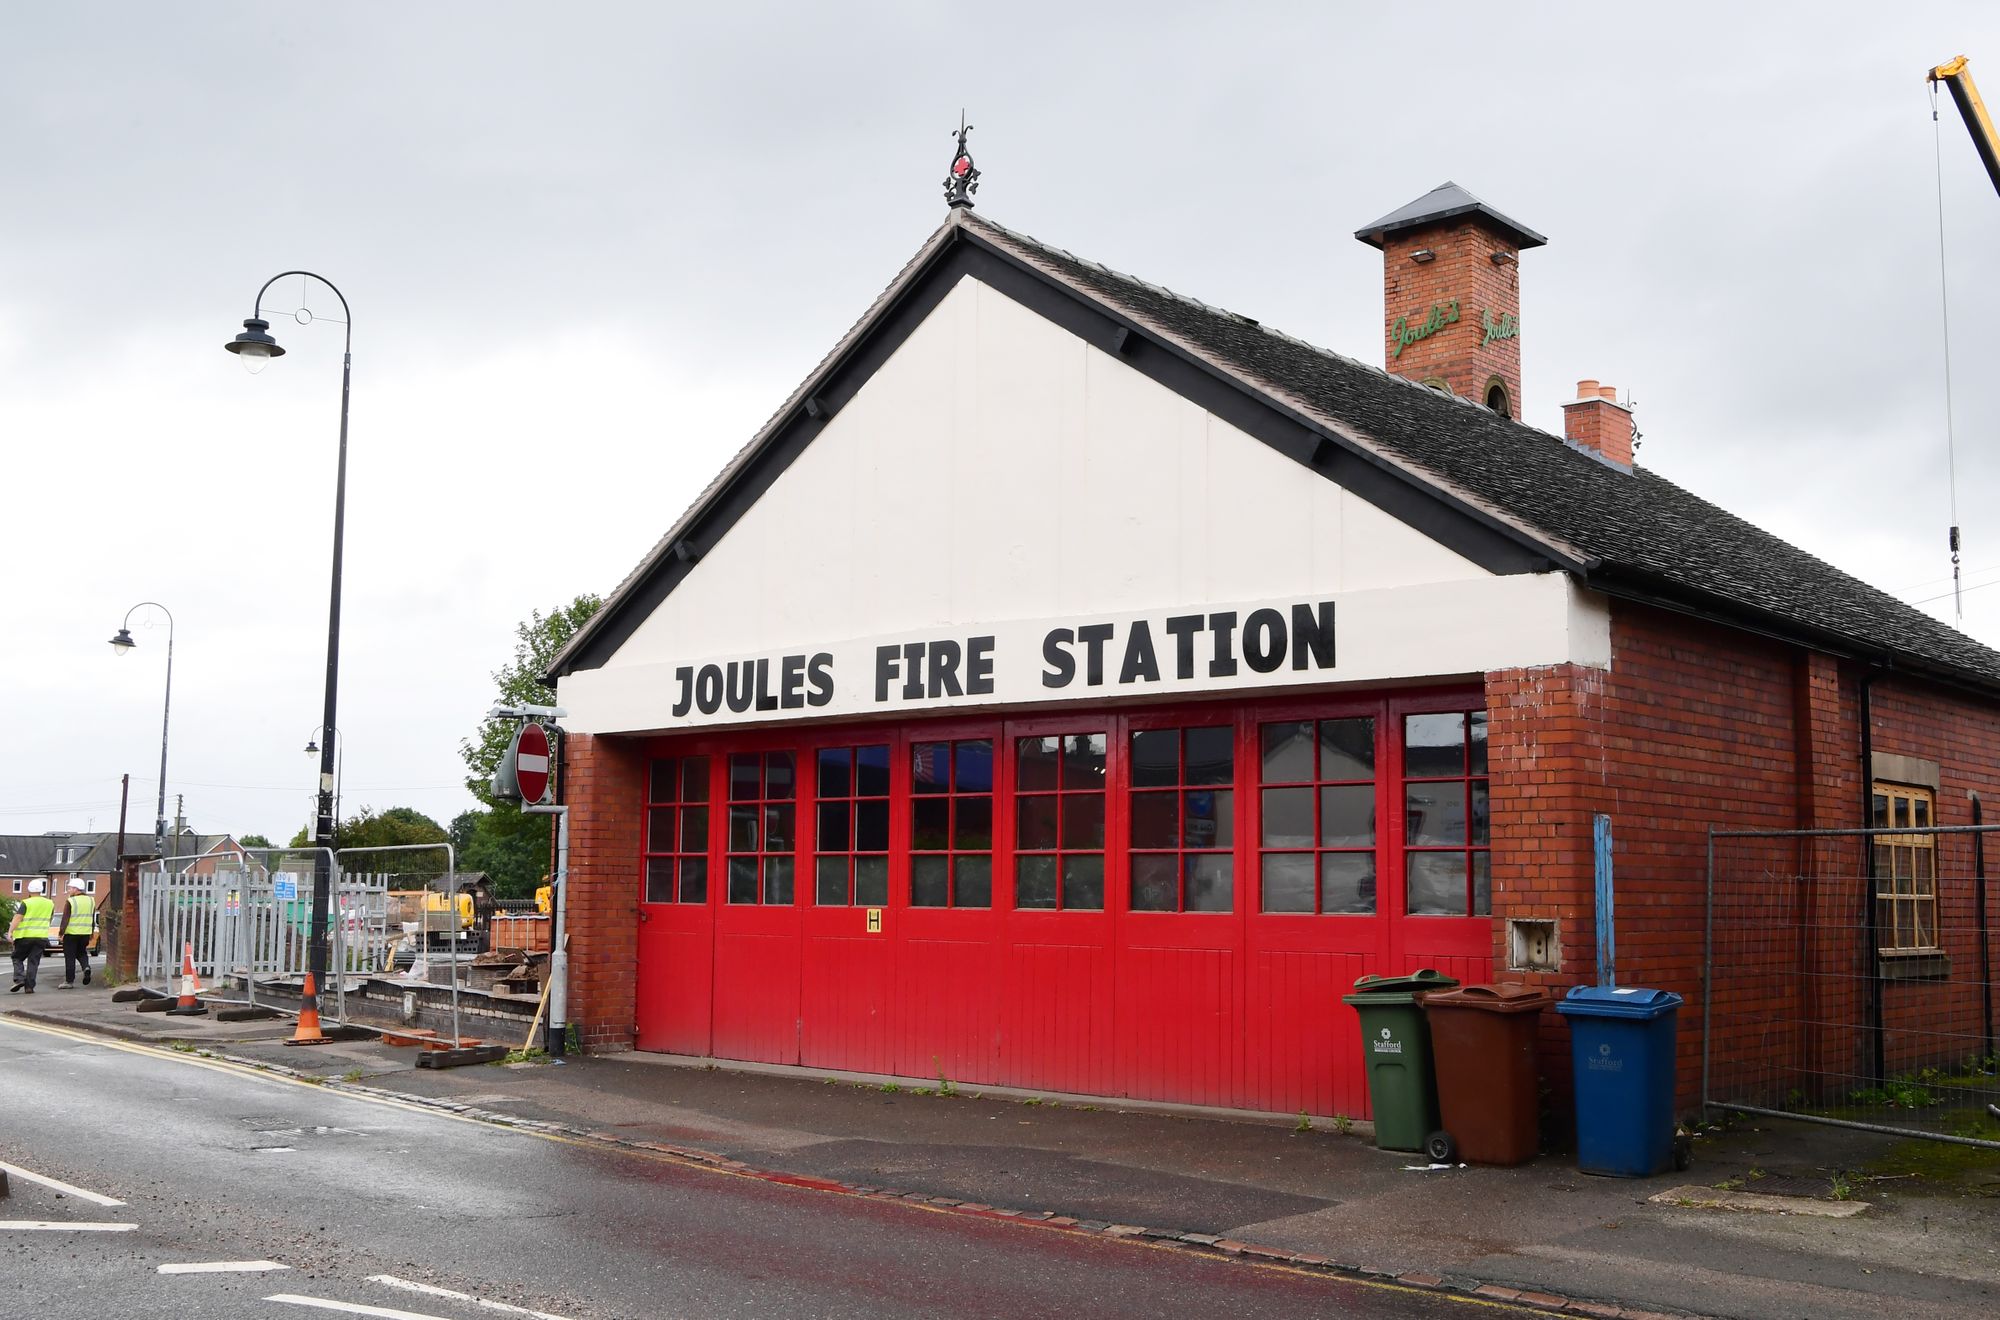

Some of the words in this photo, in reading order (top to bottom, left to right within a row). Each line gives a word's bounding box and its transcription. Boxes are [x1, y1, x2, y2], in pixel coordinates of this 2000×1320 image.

[673, 653, 834, 718] JOULES
[876, 636, 995, 702] FIRE
[1042, 602, 1336, 689] STATION
[868, 910, 880, 930] H
[1373, 1039, 1401, 1049] Stafford
[1587, 1056, 1623, 1066] Stafford
